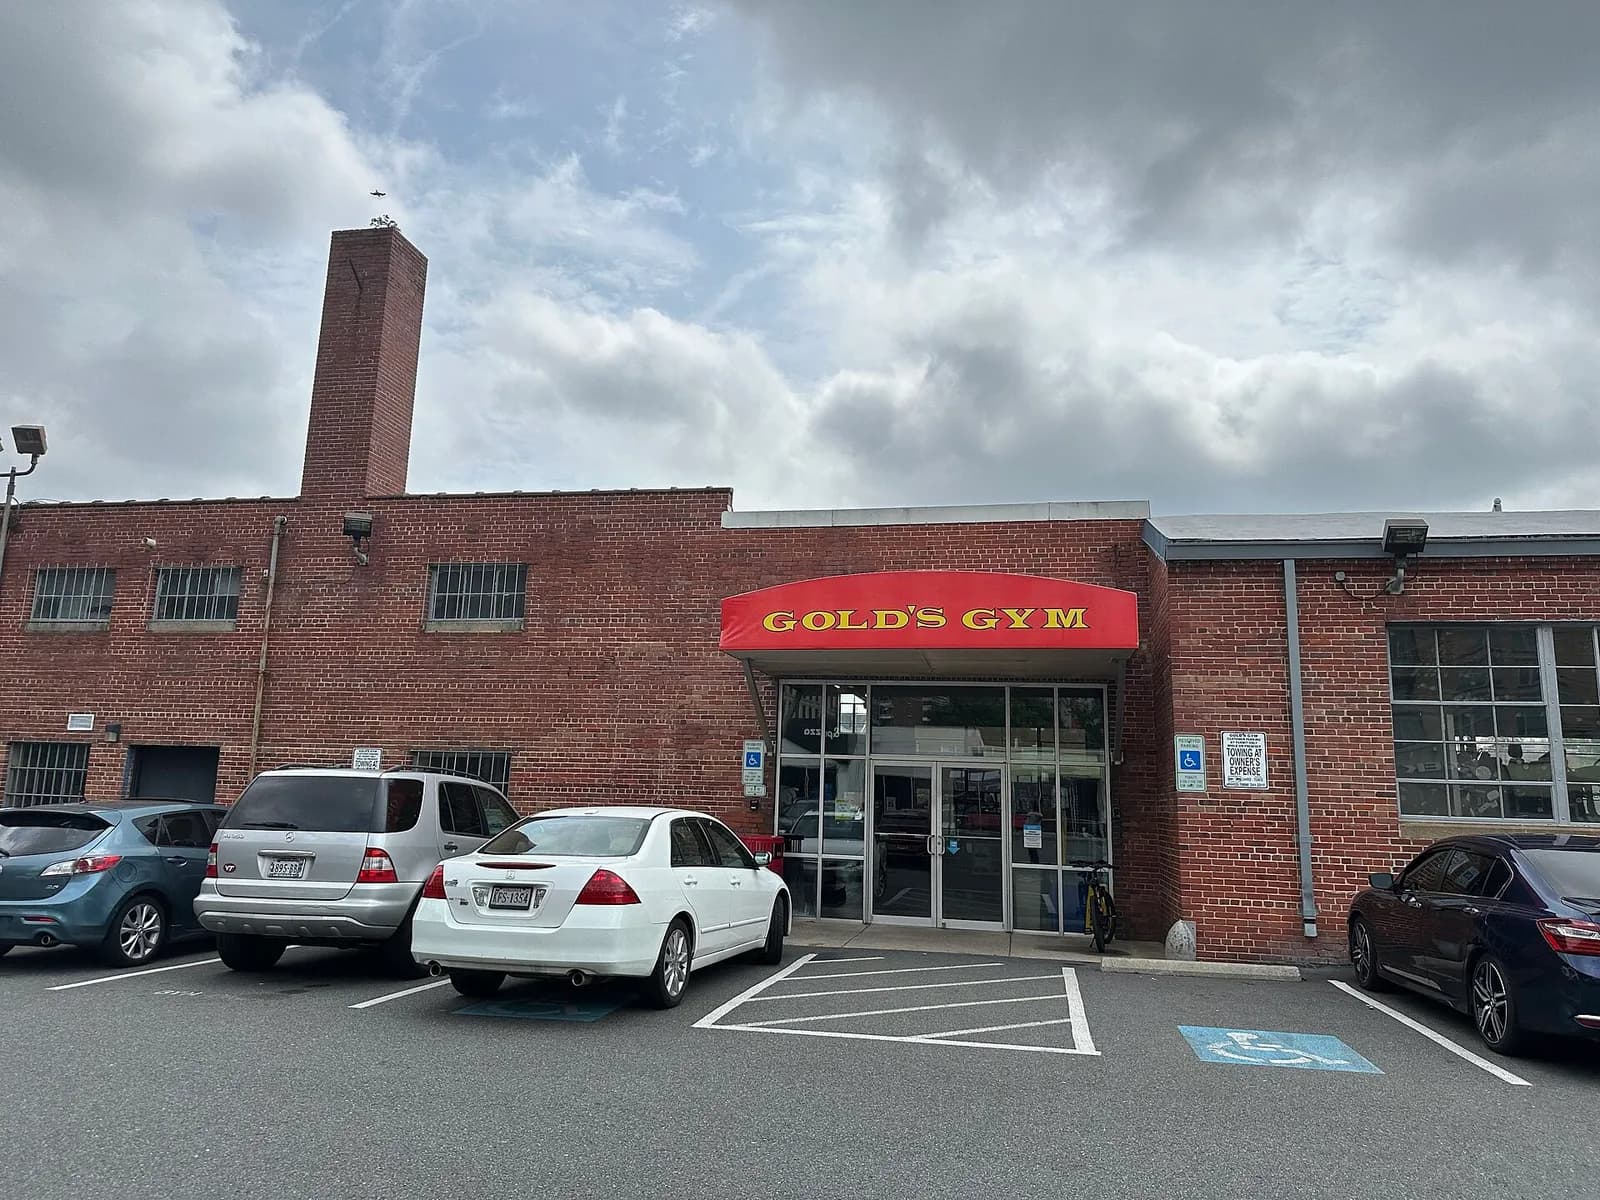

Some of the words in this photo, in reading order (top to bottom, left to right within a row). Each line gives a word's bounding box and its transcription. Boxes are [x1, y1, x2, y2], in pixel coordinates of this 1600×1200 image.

[763, 605, 948, 632] GOLD'S
[962, 607, 1090, 630] GYM
[1226, 748, 1254, 757] TOWING
[1255, 748, 1262, 757] AT
[1229, 757, 1260, 767] OWNER'S
[1230, 767, 1261, 776] EXPENSE
